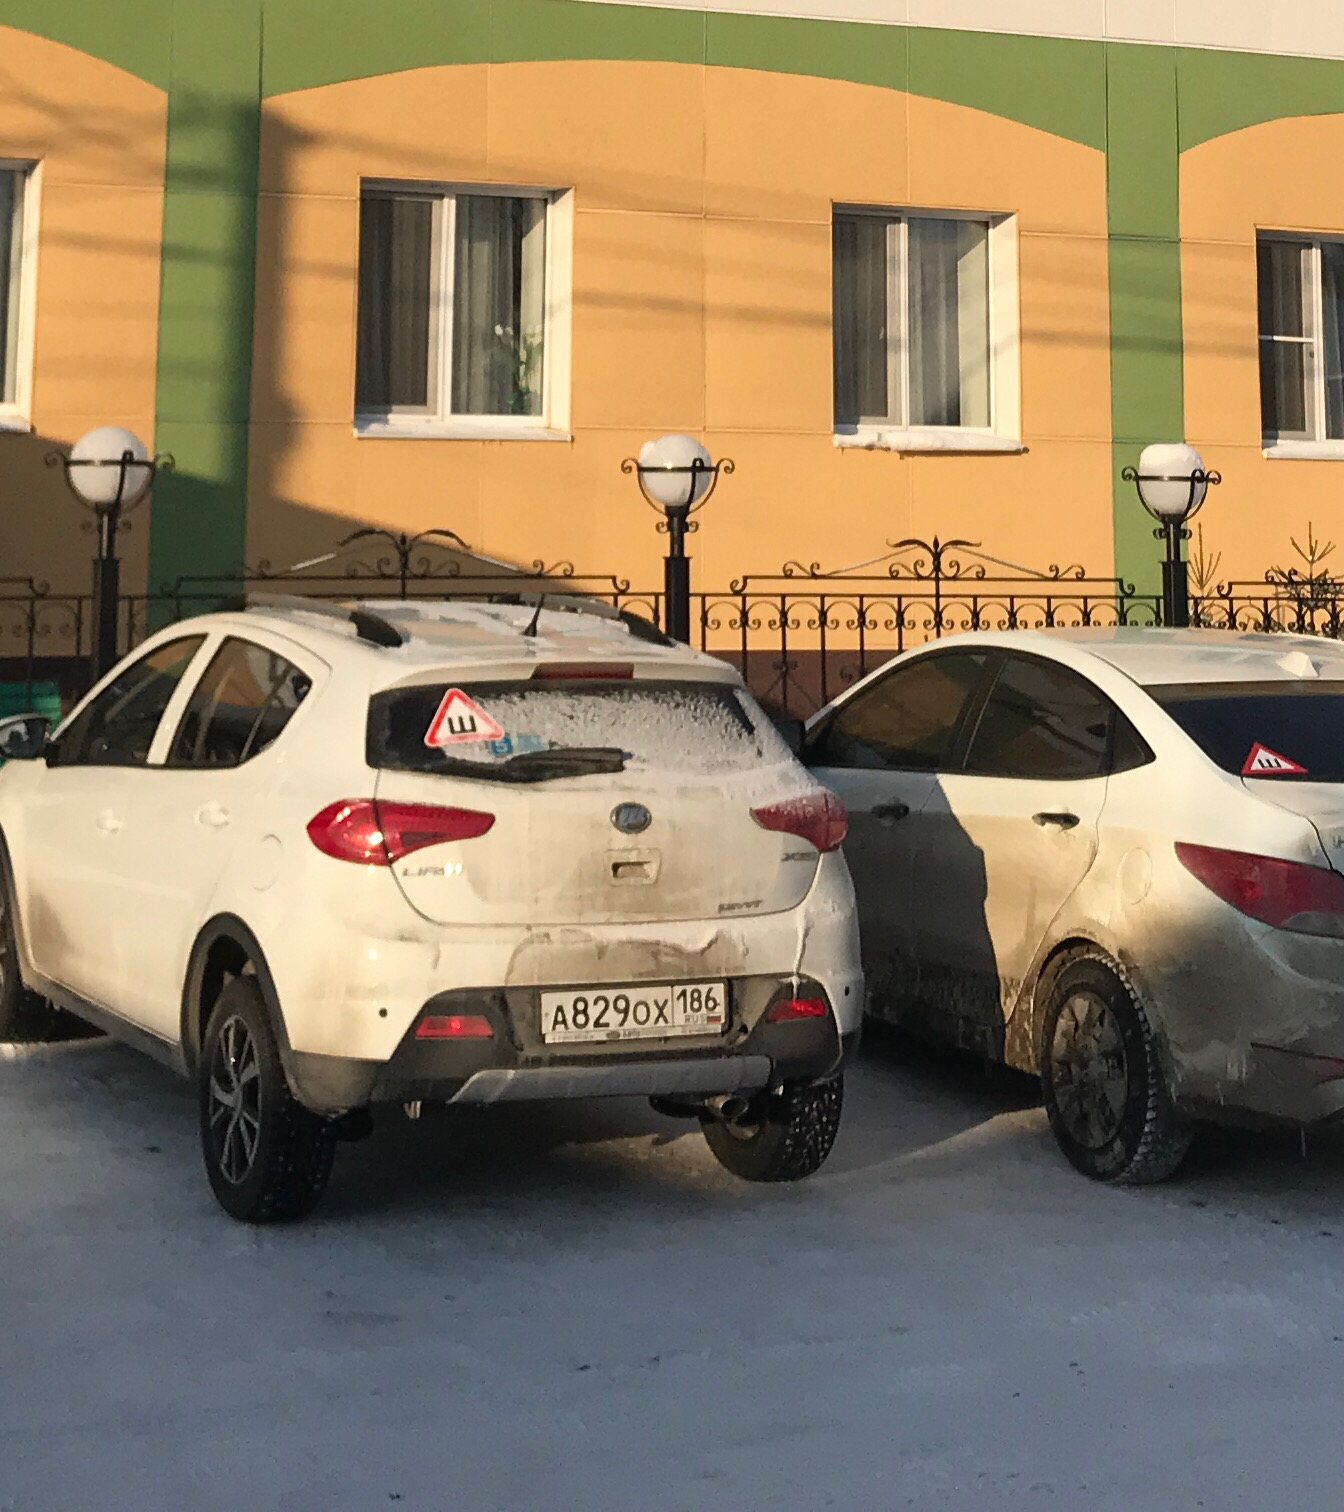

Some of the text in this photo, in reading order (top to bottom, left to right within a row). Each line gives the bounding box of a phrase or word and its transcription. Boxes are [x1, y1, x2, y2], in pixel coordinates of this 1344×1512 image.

[447, 714, 476, 735] Ш
[1257, 758, 1282, 769] Ш
[675, 987, 718, 1015] 186
